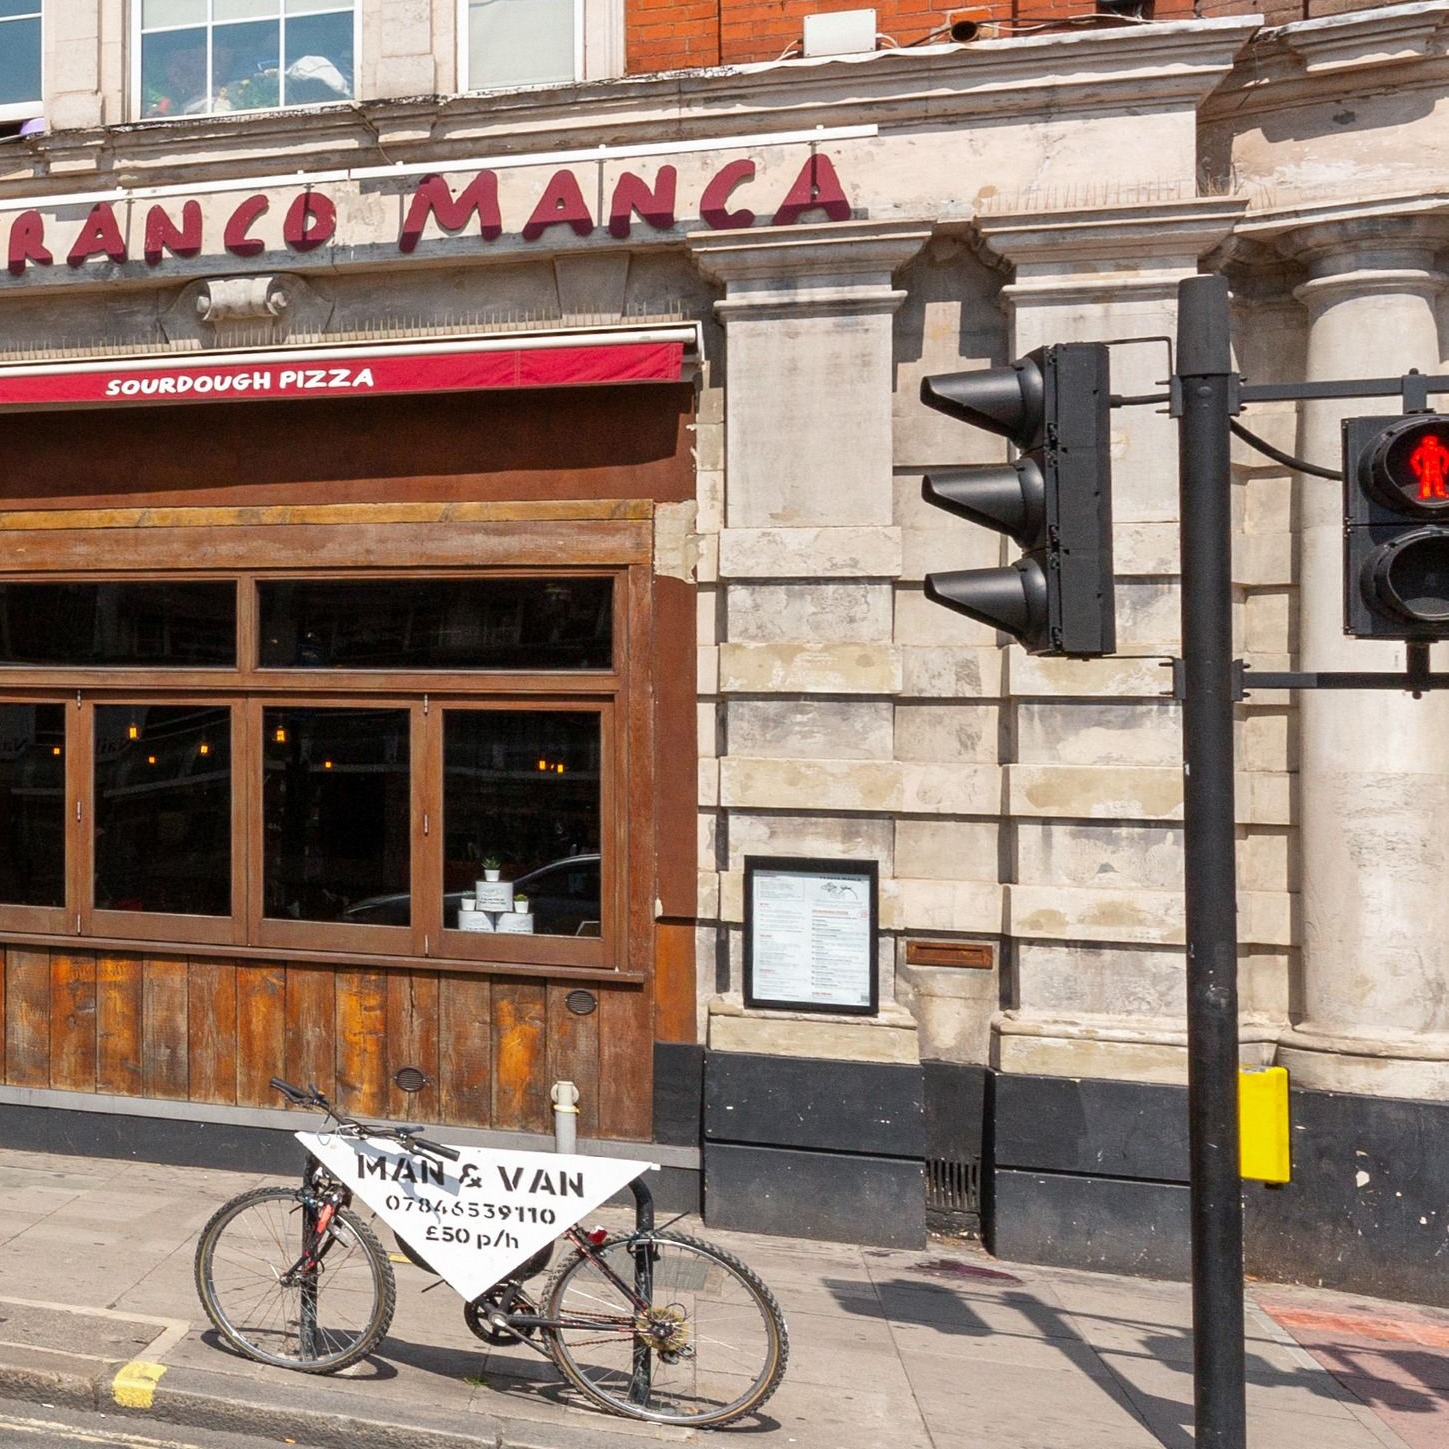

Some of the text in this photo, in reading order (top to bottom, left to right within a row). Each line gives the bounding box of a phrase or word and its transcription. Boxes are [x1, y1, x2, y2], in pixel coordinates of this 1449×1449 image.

[398, 152, 853, 253] MANCA
[104, 365, 375, 397] SOURDOUGH PIZZA
[357, 1154, 585, 1198] MAN & VAN
[385, 1195, 557, 1225] 07846539110
[426, 1225, 519, 1250] £50 p/h
